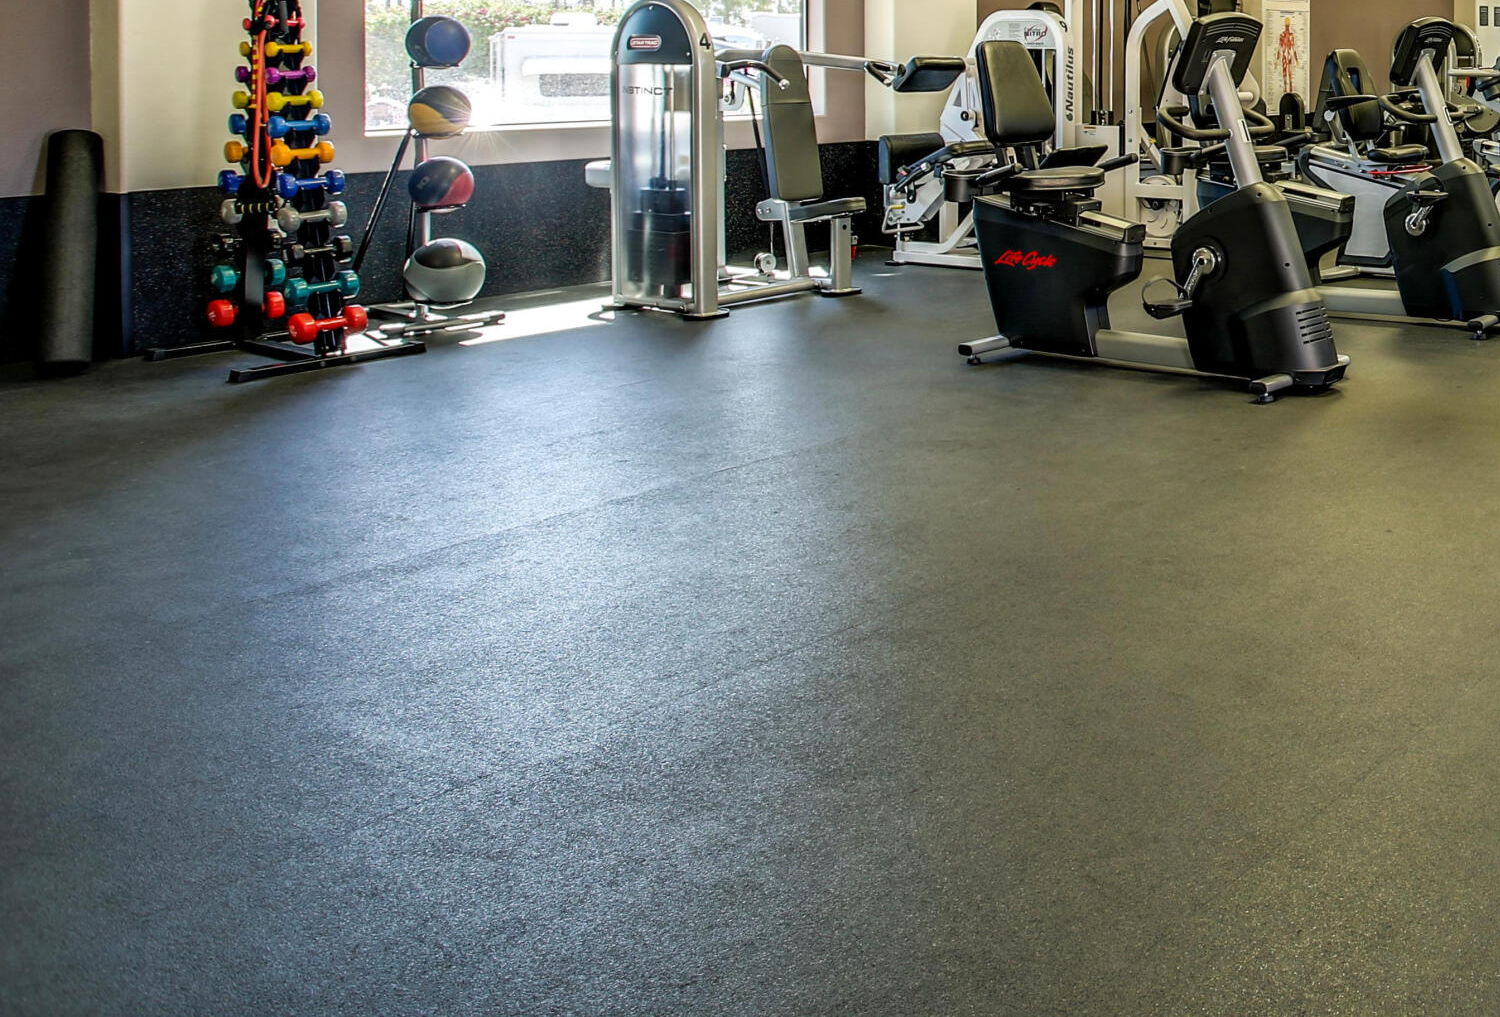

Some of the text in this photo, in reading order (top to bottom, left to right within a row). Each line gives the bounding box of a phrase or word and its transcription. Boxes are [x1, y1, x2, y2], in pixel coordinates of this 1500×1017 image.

[699, 32, 711, 50] 4
[1065, 46, 1074, 113] Nautilus
[622, 86, 673, 96] STINCT
